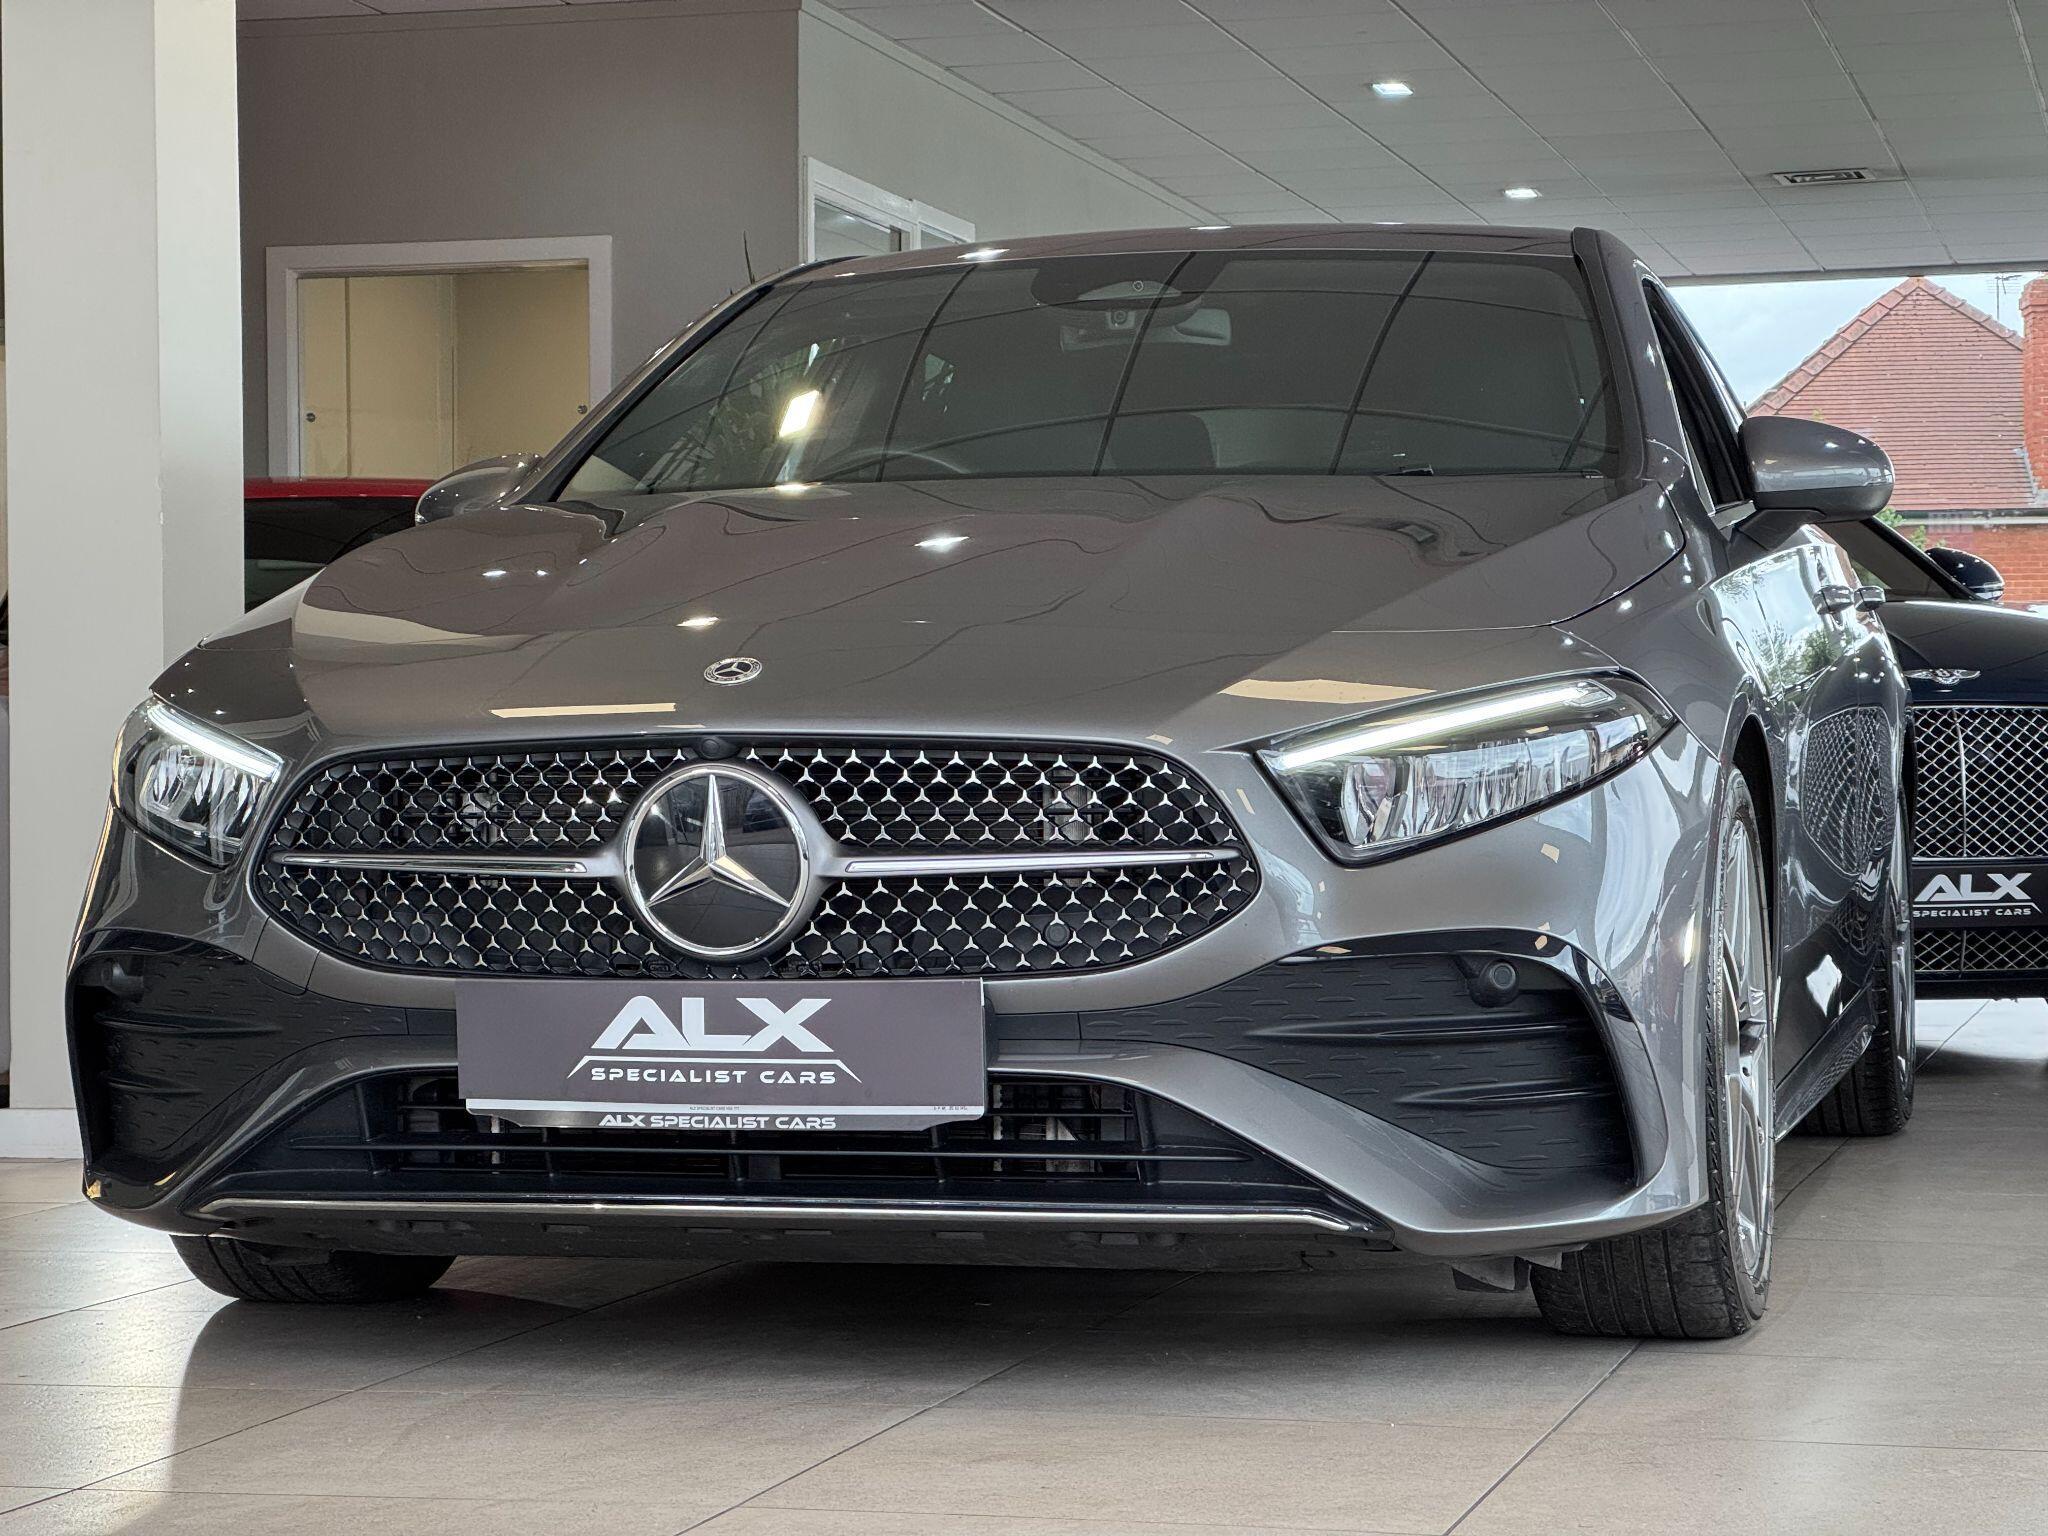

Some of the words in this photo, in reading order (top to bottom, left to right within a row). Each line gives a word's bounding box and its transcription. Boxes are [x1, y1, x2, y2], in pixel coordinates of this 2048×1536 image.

[1914, 872, 2032, 902] ALX
[1912, 909, 1990, 917] SPECIALIST
[1995, 908, 2032, 916] CARS
[590, 995, 835, 1052] ALX
[591, 1067, 748, 1084] SPECIALIST
[759, 1070, 836, 1085] CARS
[598, 1114, 646, 1128] ALX
[650, 1115, 770, 1129] SPECIALIST
[775, 1116, 837, 1130] CARS
